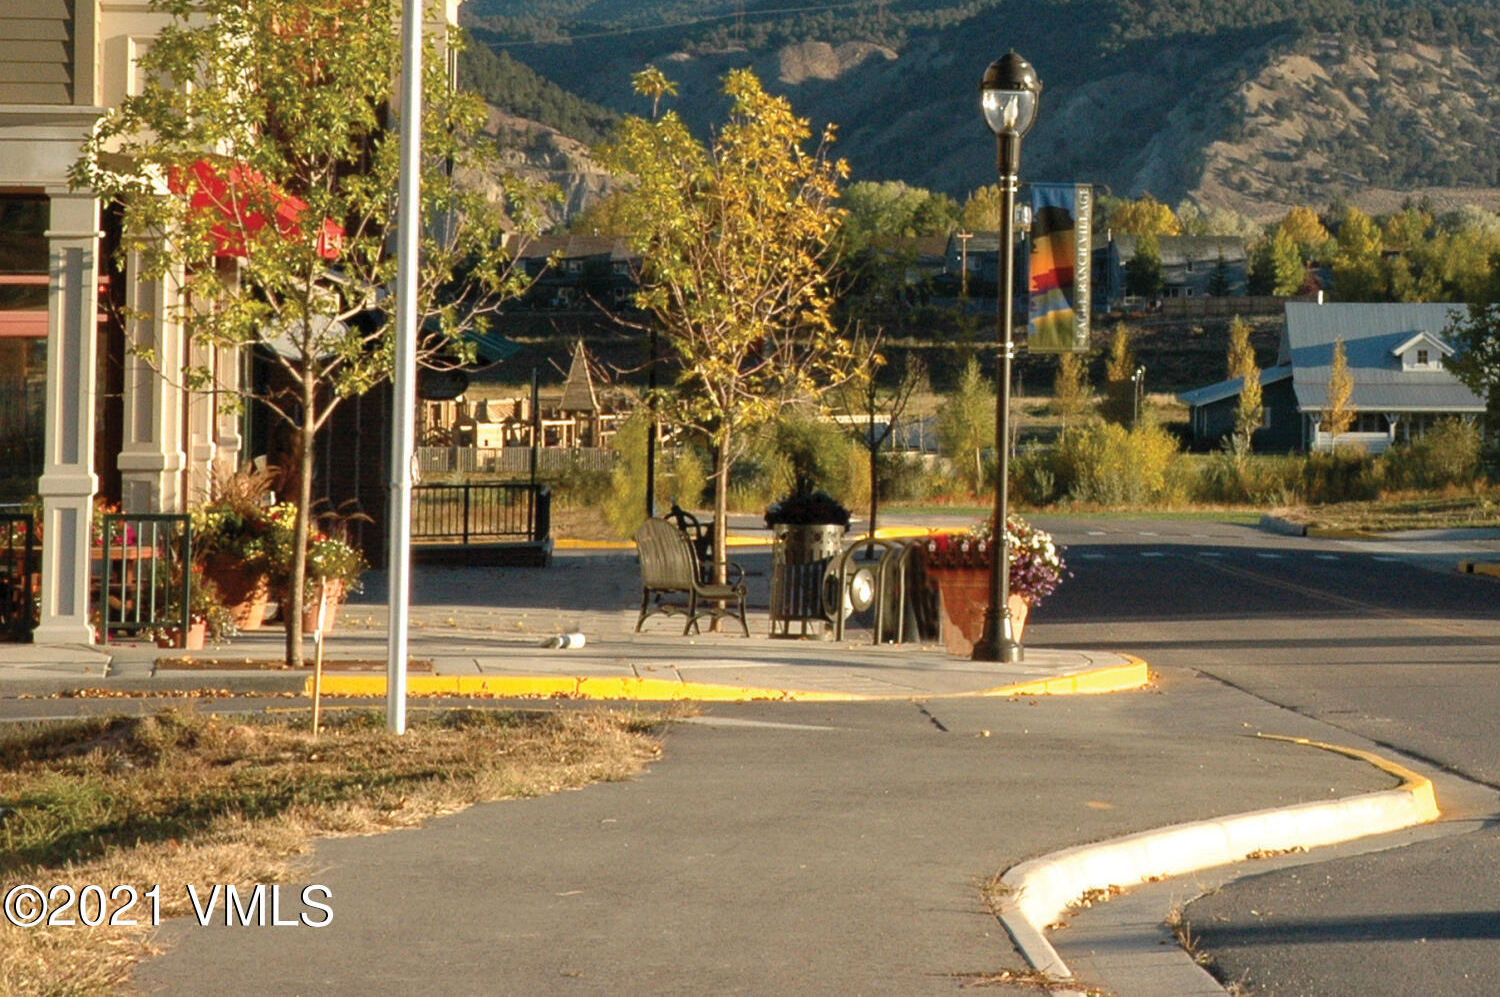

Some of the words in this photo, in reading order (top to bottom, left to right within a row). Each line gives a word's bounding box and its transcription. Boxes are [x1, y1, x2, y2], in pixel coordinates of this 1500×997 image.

[1078, 187, 1090, 243] VILLAGE
[1077, 246, 1088, 292] RANCH
[1076, 296, 1087, 339] EAGLE
